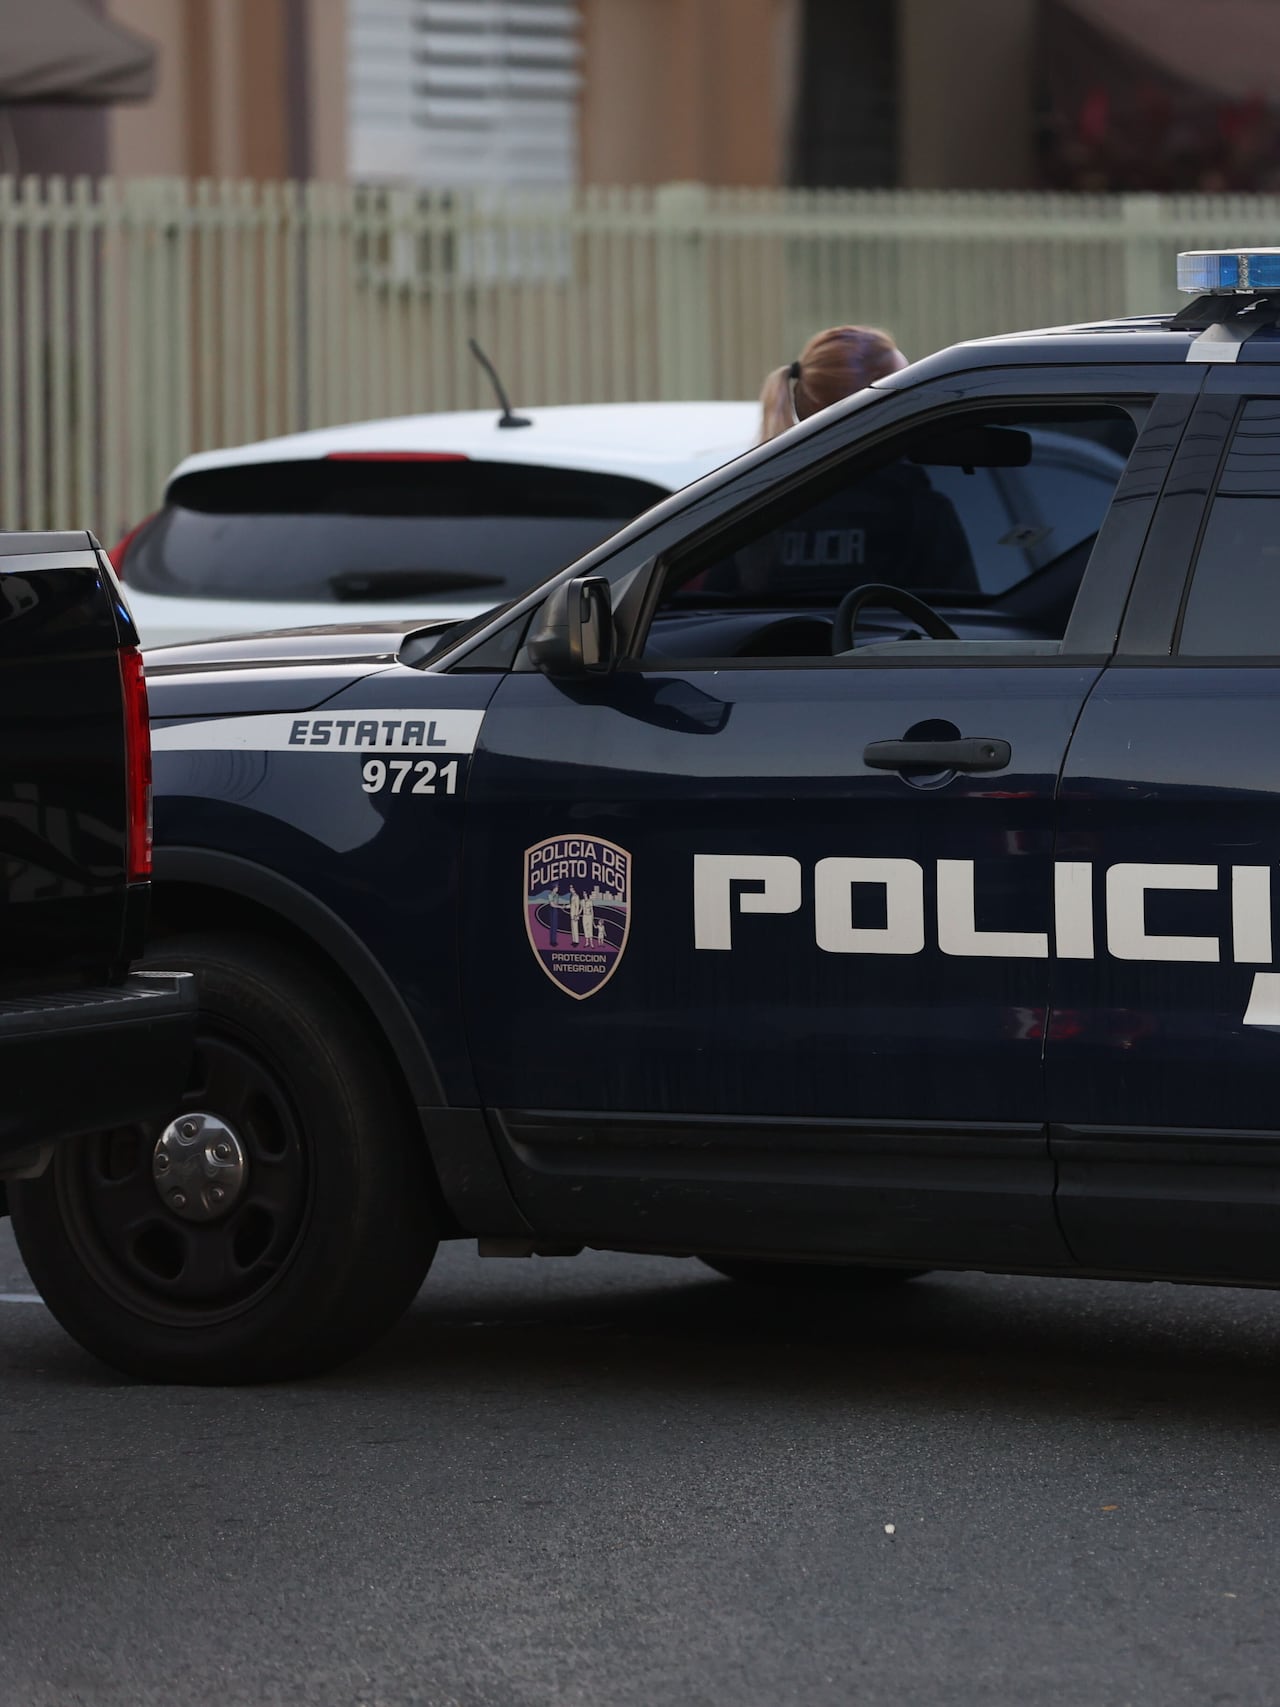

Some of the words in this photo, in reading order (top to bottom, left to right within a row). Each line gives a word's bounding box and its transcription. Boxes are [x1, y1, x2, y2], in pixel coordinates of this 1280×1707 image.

[782, 528, 866, 567] OLICIA
[288, 720, 447, 746] ESTATAL
[361, 759, 458, 795] 9721
[531, 841, 597, 870] POLICIA
[602, 847, 626, 874] DE
[530, 860, 588, 890] PUERTO
[592, 864, 625, 893] RICO
[551, 953, 607, 963] PROTECCION
[553, 963, 606, 973] INTEGRIDAD
